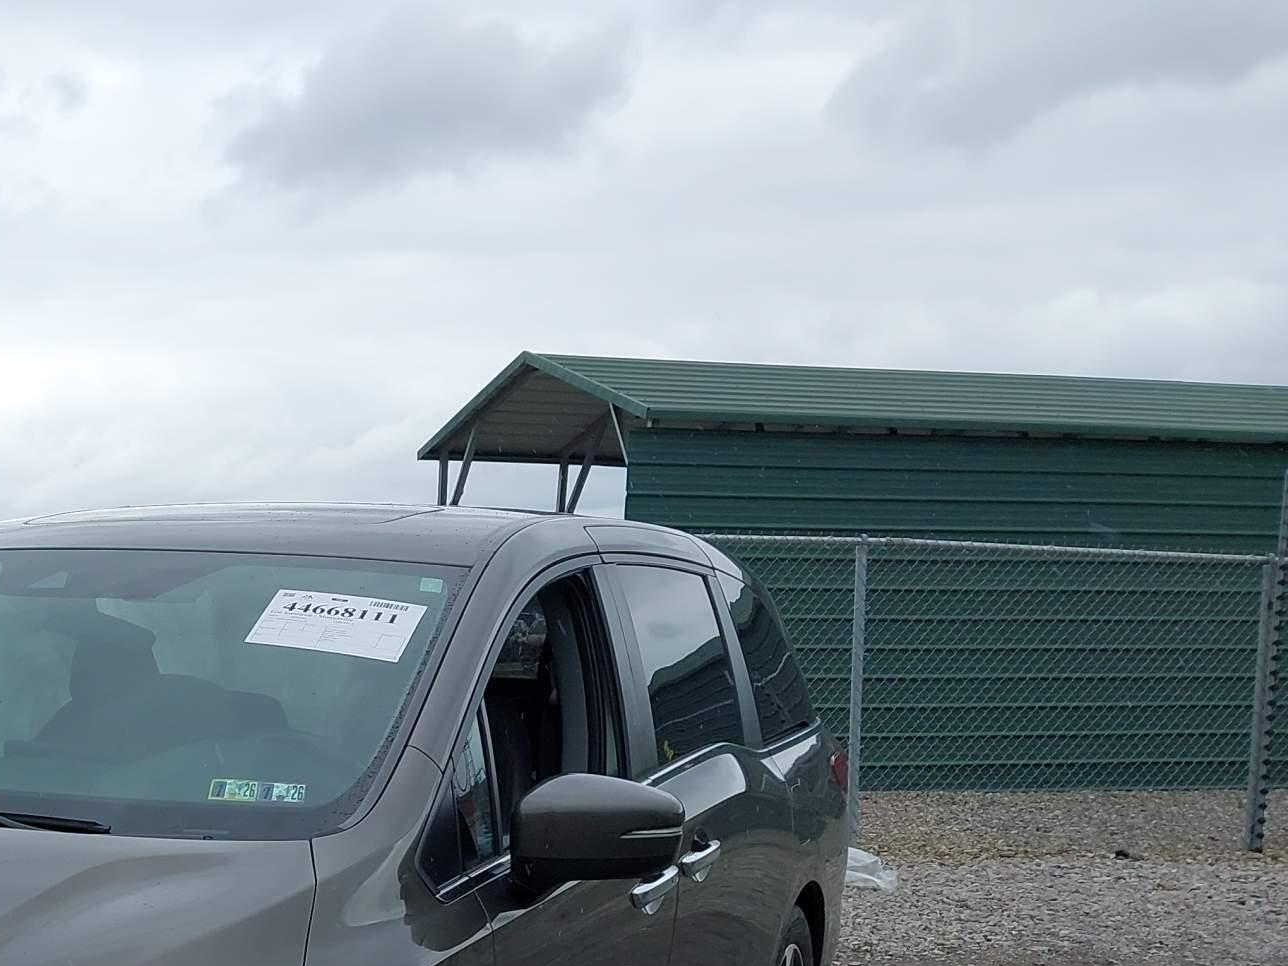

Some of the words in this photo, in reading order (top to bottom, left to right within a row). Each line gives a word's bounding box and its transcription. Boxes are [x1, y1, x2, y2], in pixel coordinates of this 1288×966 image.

[283, 601, 399, 624] 44668111
[243, 783, 257, 798] 26
[291, 785, 304, 800] 26
